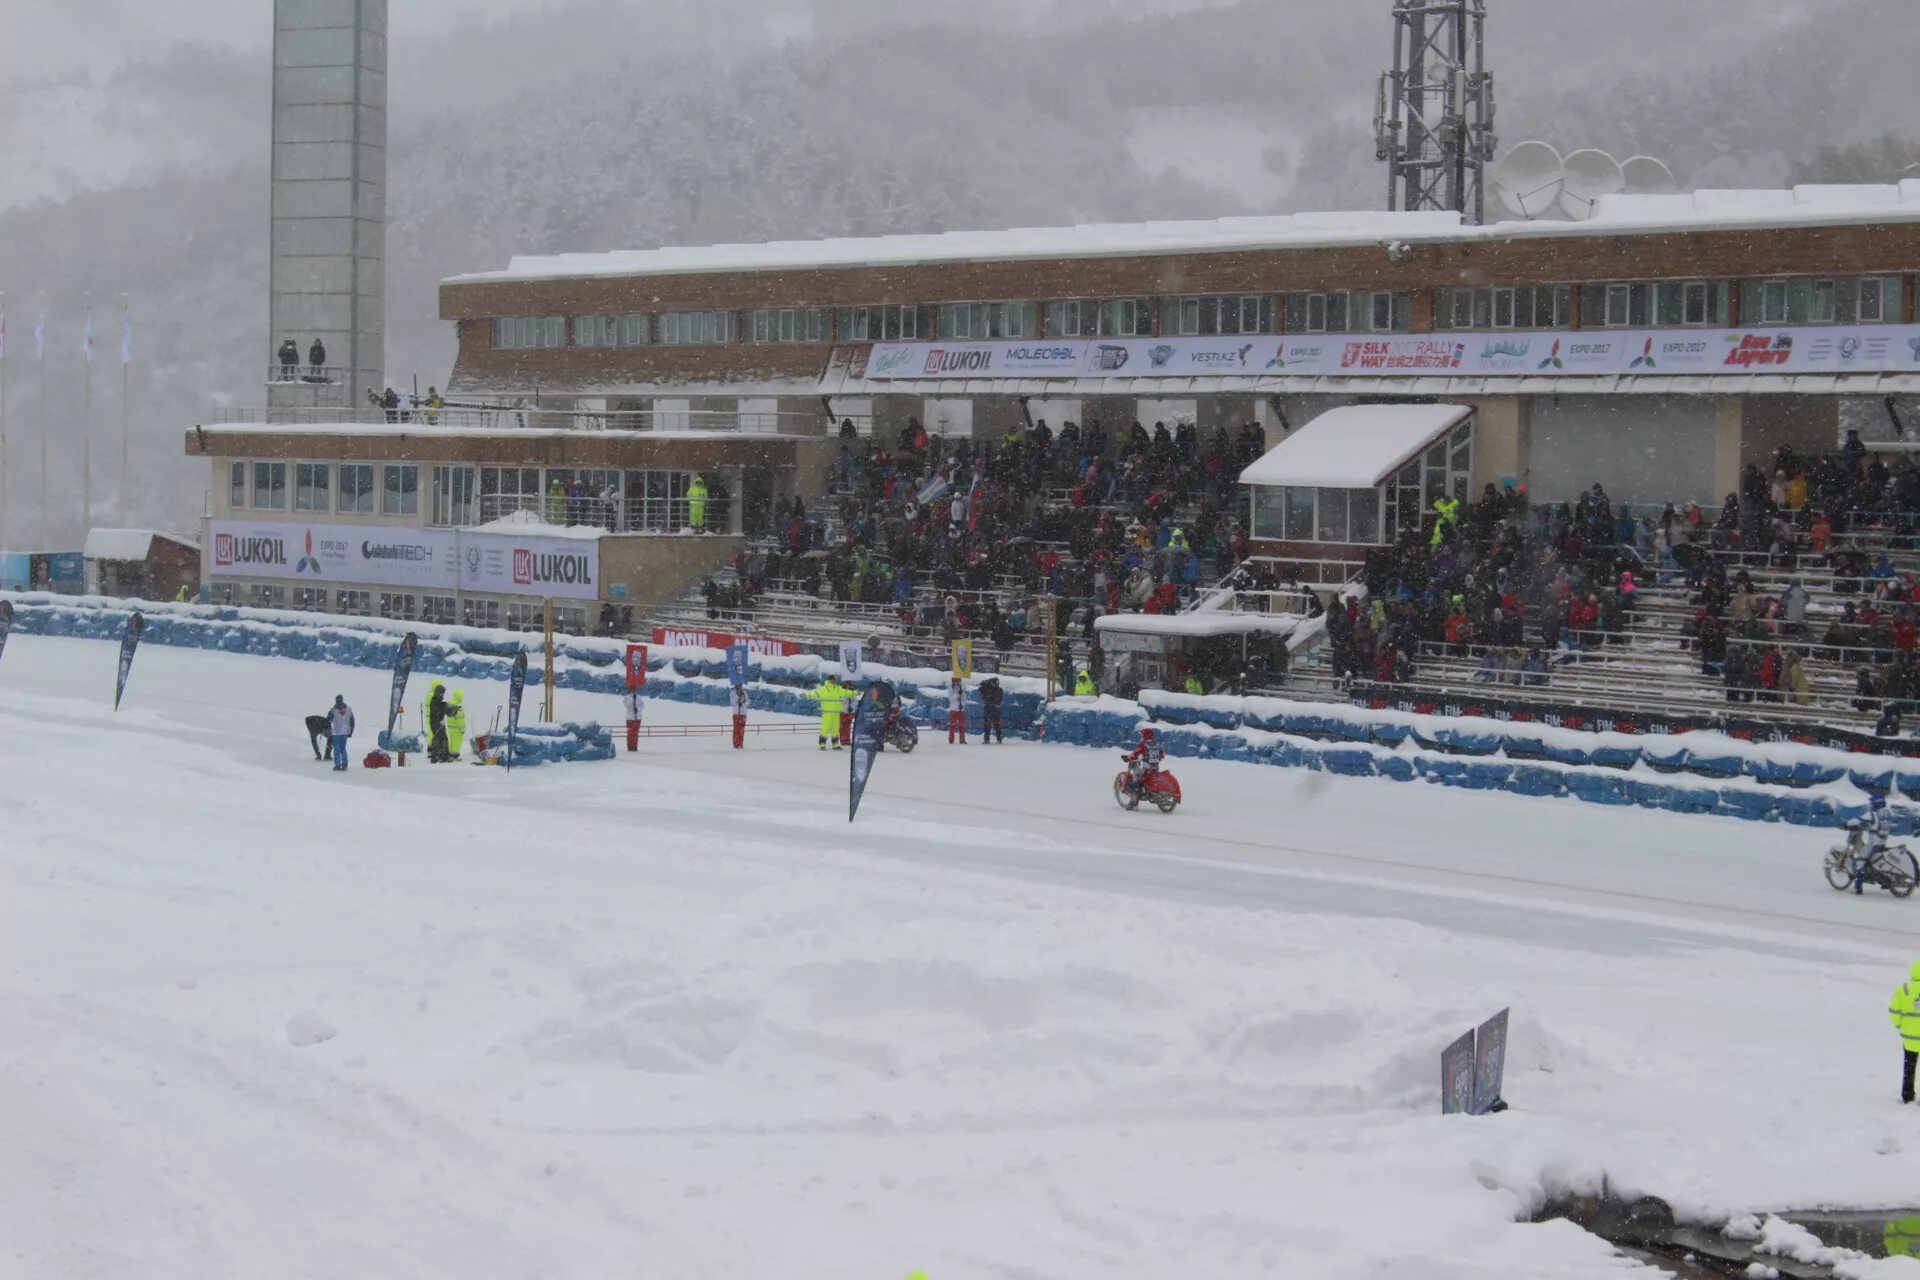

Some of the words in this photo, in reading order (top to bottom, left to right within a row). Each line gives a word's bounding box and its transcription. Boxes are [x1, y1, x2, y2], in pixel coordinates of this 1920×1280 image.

[1363, 342, 1391, 354] SILK
[1416, 341, 1455, 354] RALLY
[1569, 343, 1591, 354] EXPO
[1591, 343, 1611, 353] 2017
[1663, 342, 1685, 353] EXPO
[1685, 342, 1706, 353] 2017
[941, 351, 992, 371] LUKOIL
[1361, 355, 1386, 368] WAY
[234, 537, 287, 565] LUKOIL
[320, 540, 334, 551] EXPO
[532, 553, 592, 585] LUKOIL
